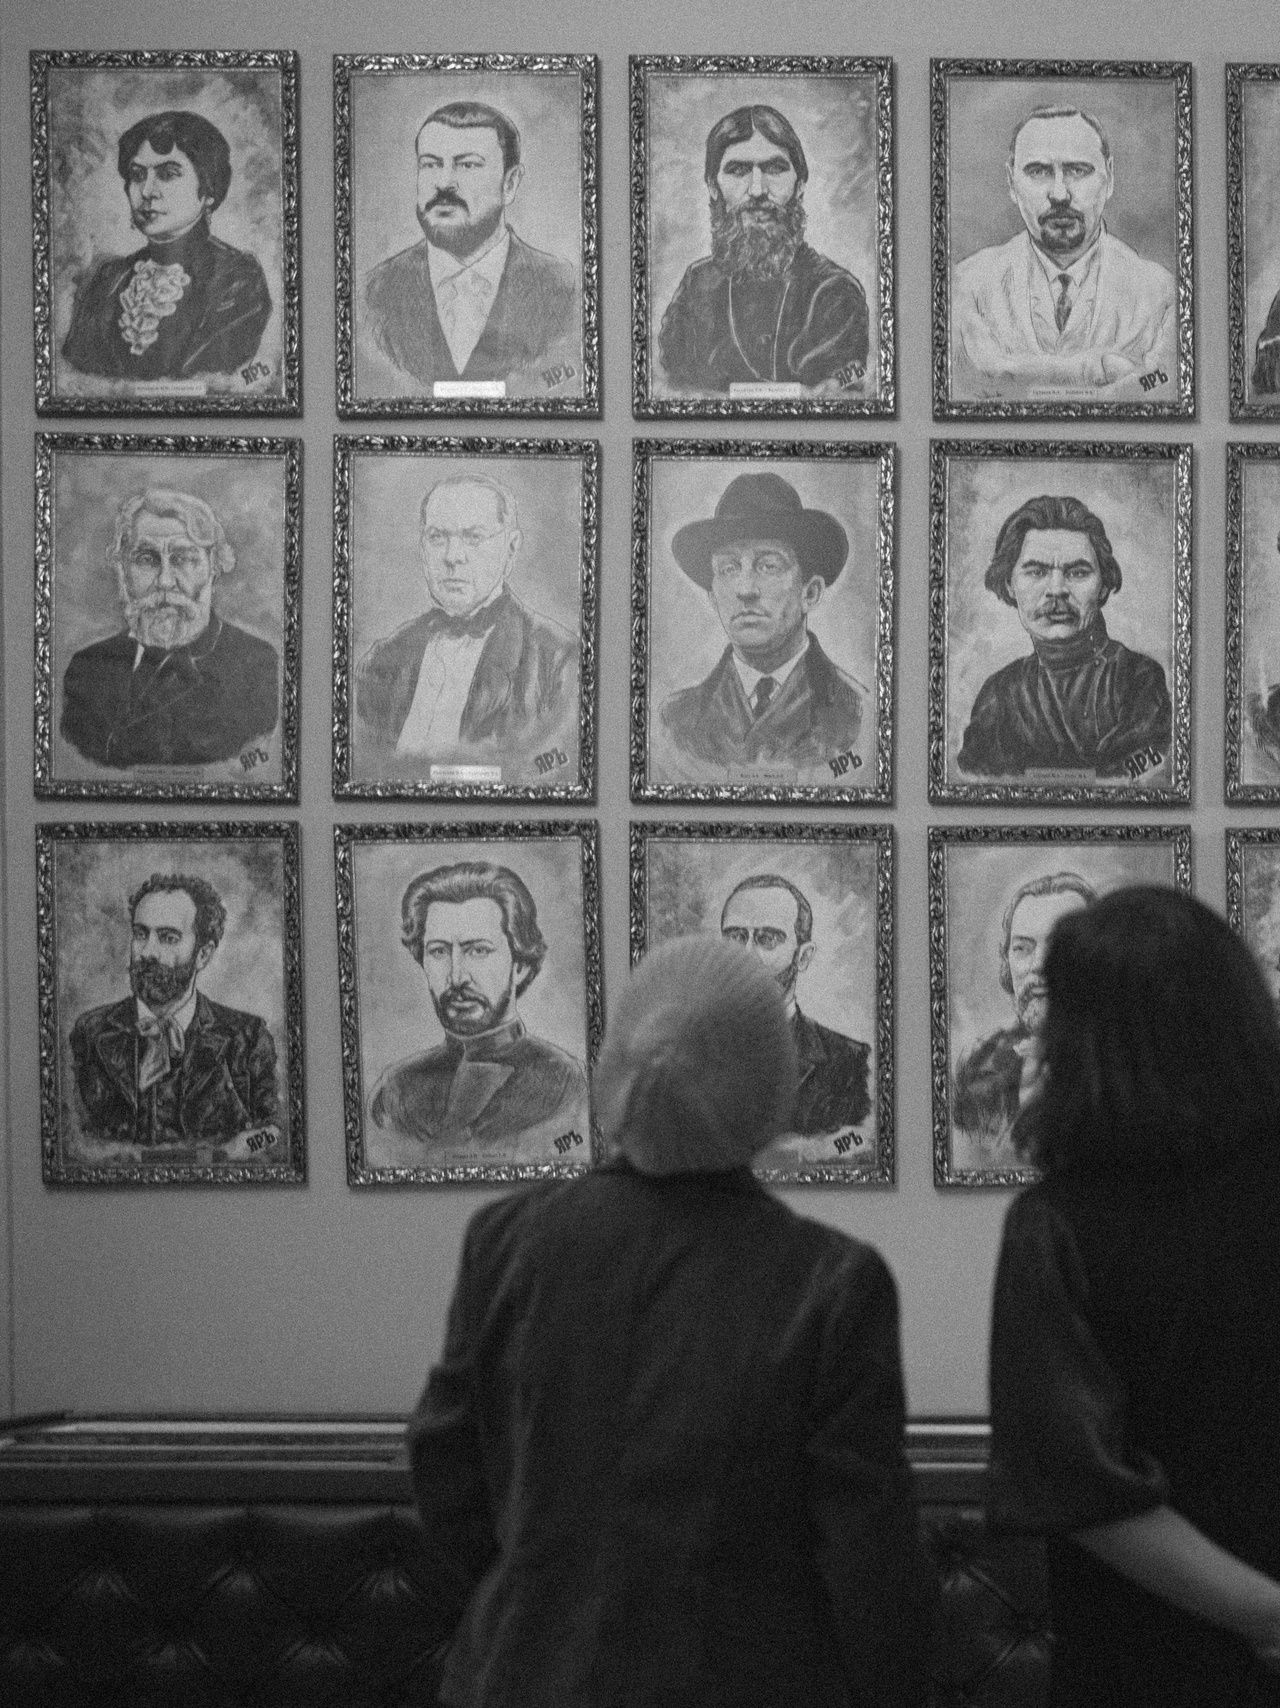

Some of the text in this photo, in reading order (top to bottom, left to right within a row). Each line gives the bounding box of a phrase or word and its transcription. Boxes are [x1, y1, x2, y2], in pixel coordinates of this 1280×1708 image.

[241, 361, 271, 385] ЯРЪ
[1139, 368, 1169, 392] ЯРЪ
[239, 748, 269, 772] ЯРЪ
[534, 747, 568, 775] ЯРЪ
[828, 750, 863, 778] ЯРЪ
[1124, 746, 1162, 780] ЯРЪ
[246, 1130, 276, 1153] ЯРЪ
[554, 1130, 584, 1154] ЯРЪ
[833, 1131, 863, 1154] ЯРЪ
